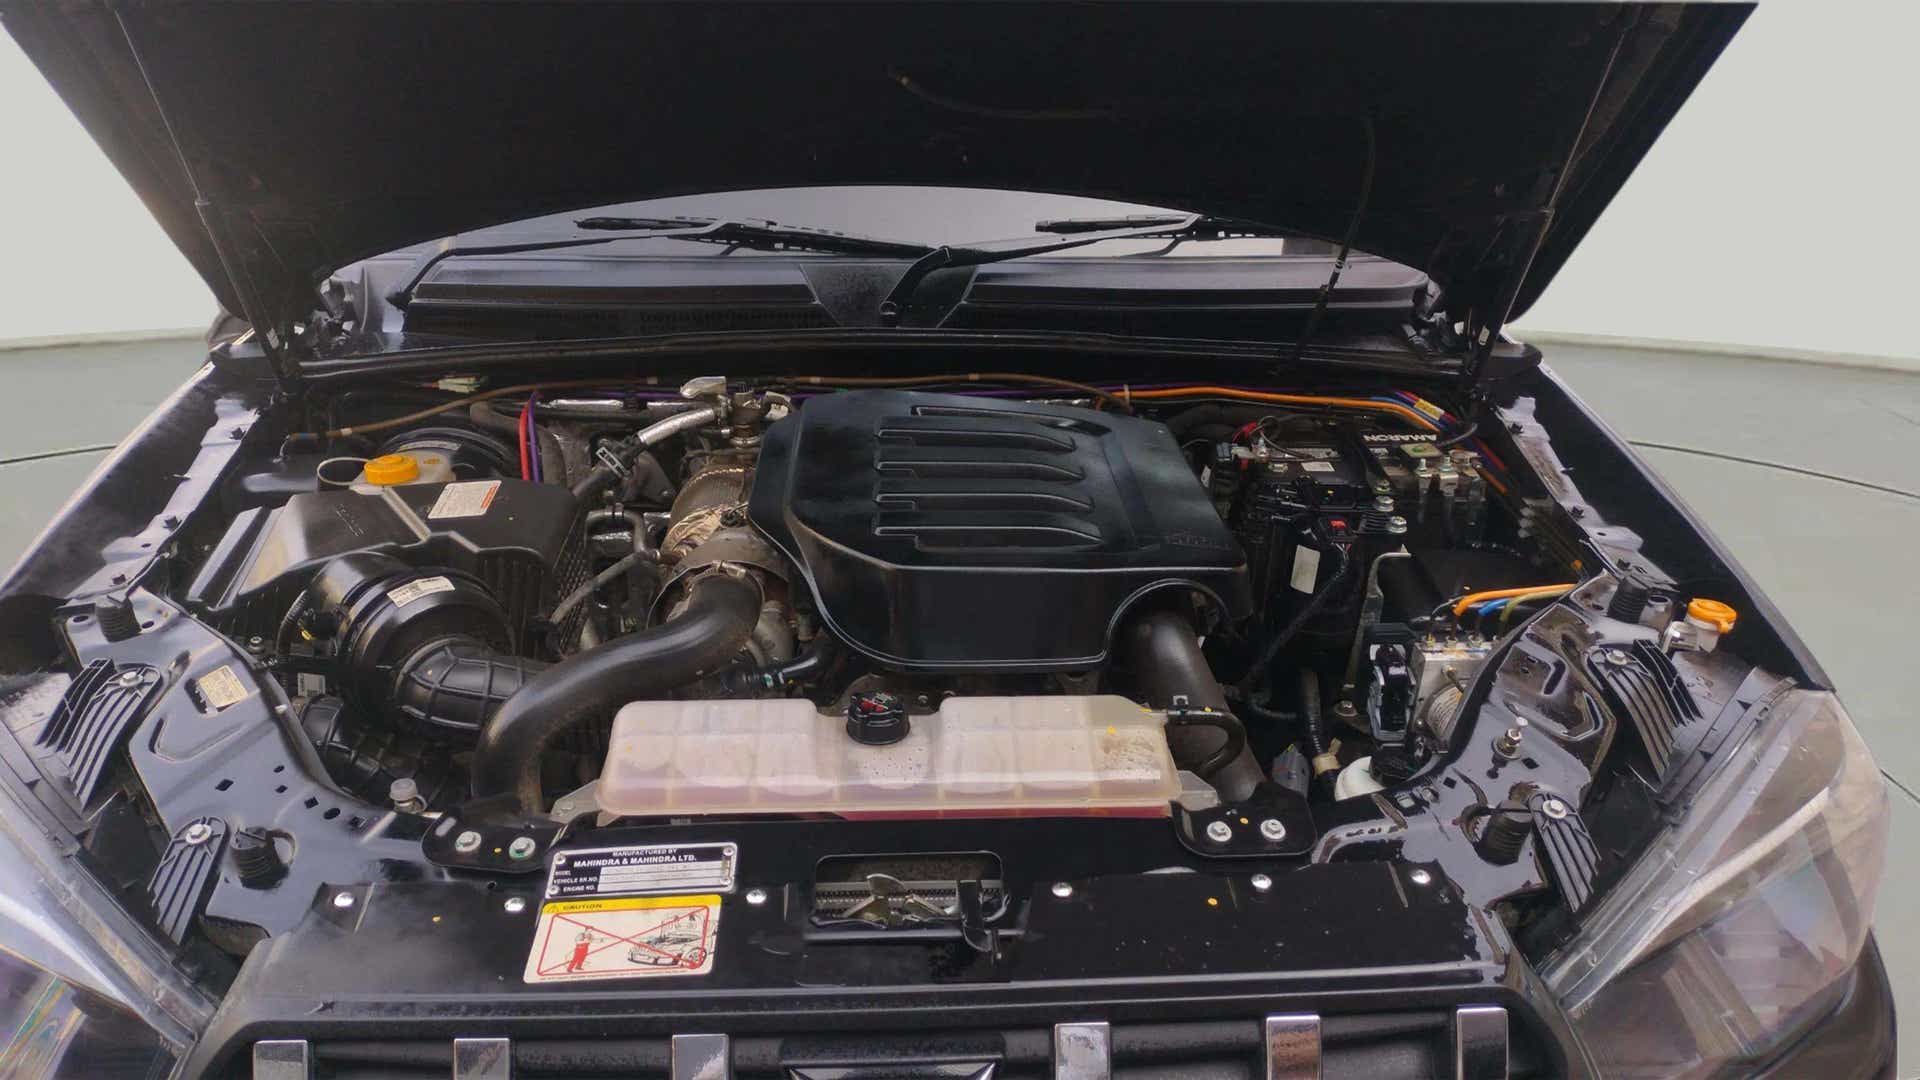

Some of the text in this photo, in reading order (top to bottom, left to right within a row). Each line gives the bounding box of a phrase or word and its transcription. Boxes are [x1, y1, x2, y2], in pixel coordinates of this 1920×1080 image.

[613, 849, 667, 857] MANUFACTURED
[573, 860, 620, 868] MAHINDRA
[630, 856, 677, 865] MAHINDRA
